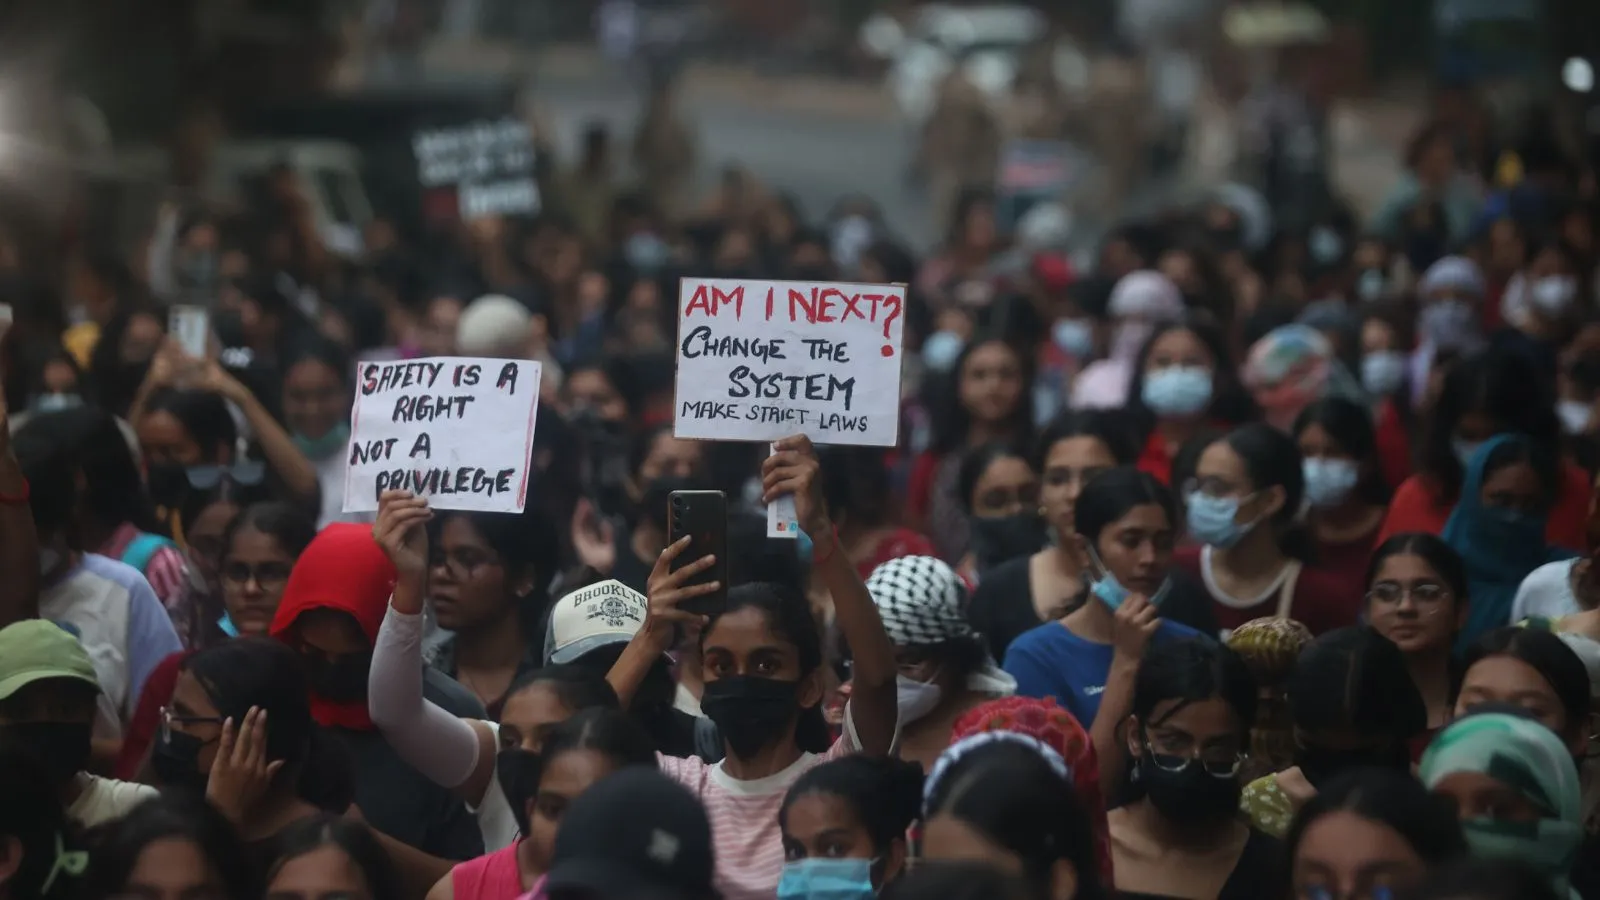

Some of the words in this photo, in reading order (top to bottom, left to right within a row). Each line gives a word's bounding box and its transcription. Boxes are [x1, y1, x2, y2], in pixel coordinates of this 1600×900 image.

[685, 285, 744, 321] AM
[765, 287, 773, 321] I
[788, 287, 901, 357] NEXT?
[681, 326, 786, 364] CHANGE
[801, 339, 850, 362] THE
[362, 363, 444, 395] SAFETY
[452, 365, 481, 387] IS
[496, 362, 518, 394] A
[728, 365, 855, 411] SYSTEM
[392, 395, 475, 423] RIGHT
[681, 401, 739, 419] MAKE
[745, 405, 809, 424] STRICT
[819, 413, 867, 432] LAWS
[350, 438, 399, 465] NOT
[409, 432, 431, 459] A
[376, 467, 515, 501] PRIVILEGE
[574, 584, 648, 609] BROOKLYN
